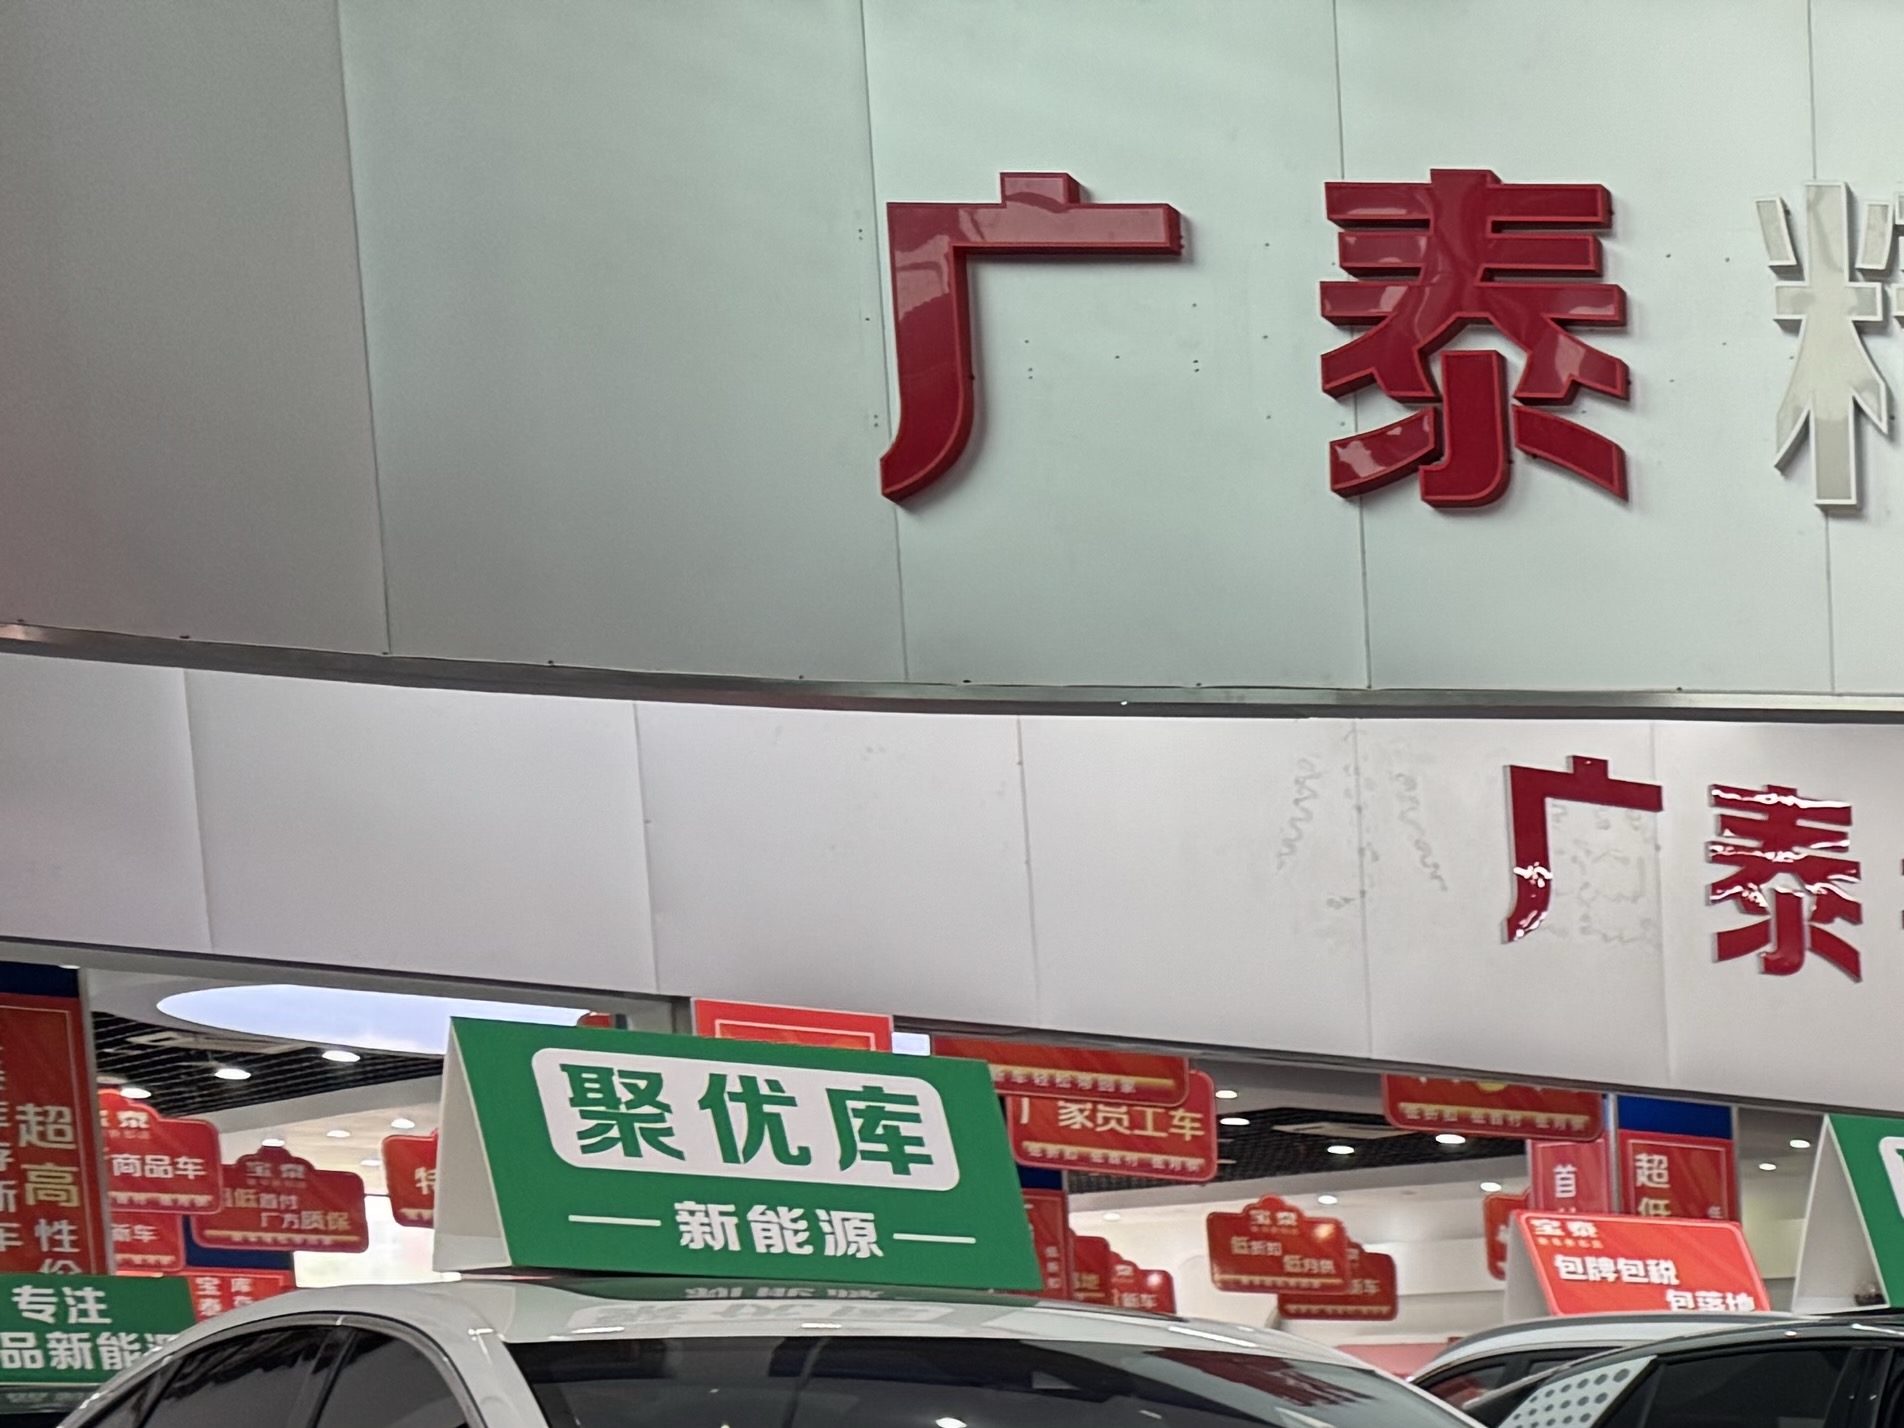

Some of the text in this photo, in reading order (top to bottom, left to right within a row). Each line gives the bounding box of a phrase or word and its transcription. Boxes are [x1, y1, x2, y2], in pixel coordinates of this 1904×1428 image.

[557, 1061, 935, 1177] 聚优库
[103, 1152, 207, 1180] 商品车
[676, 1200, 885, 1260] 新能源
[1530, 1218, 1598, 1239] 宝泰
[1554, 1253, 1681, 1286] 包牌包税
[11, 1285, 113, 1325] 专注
